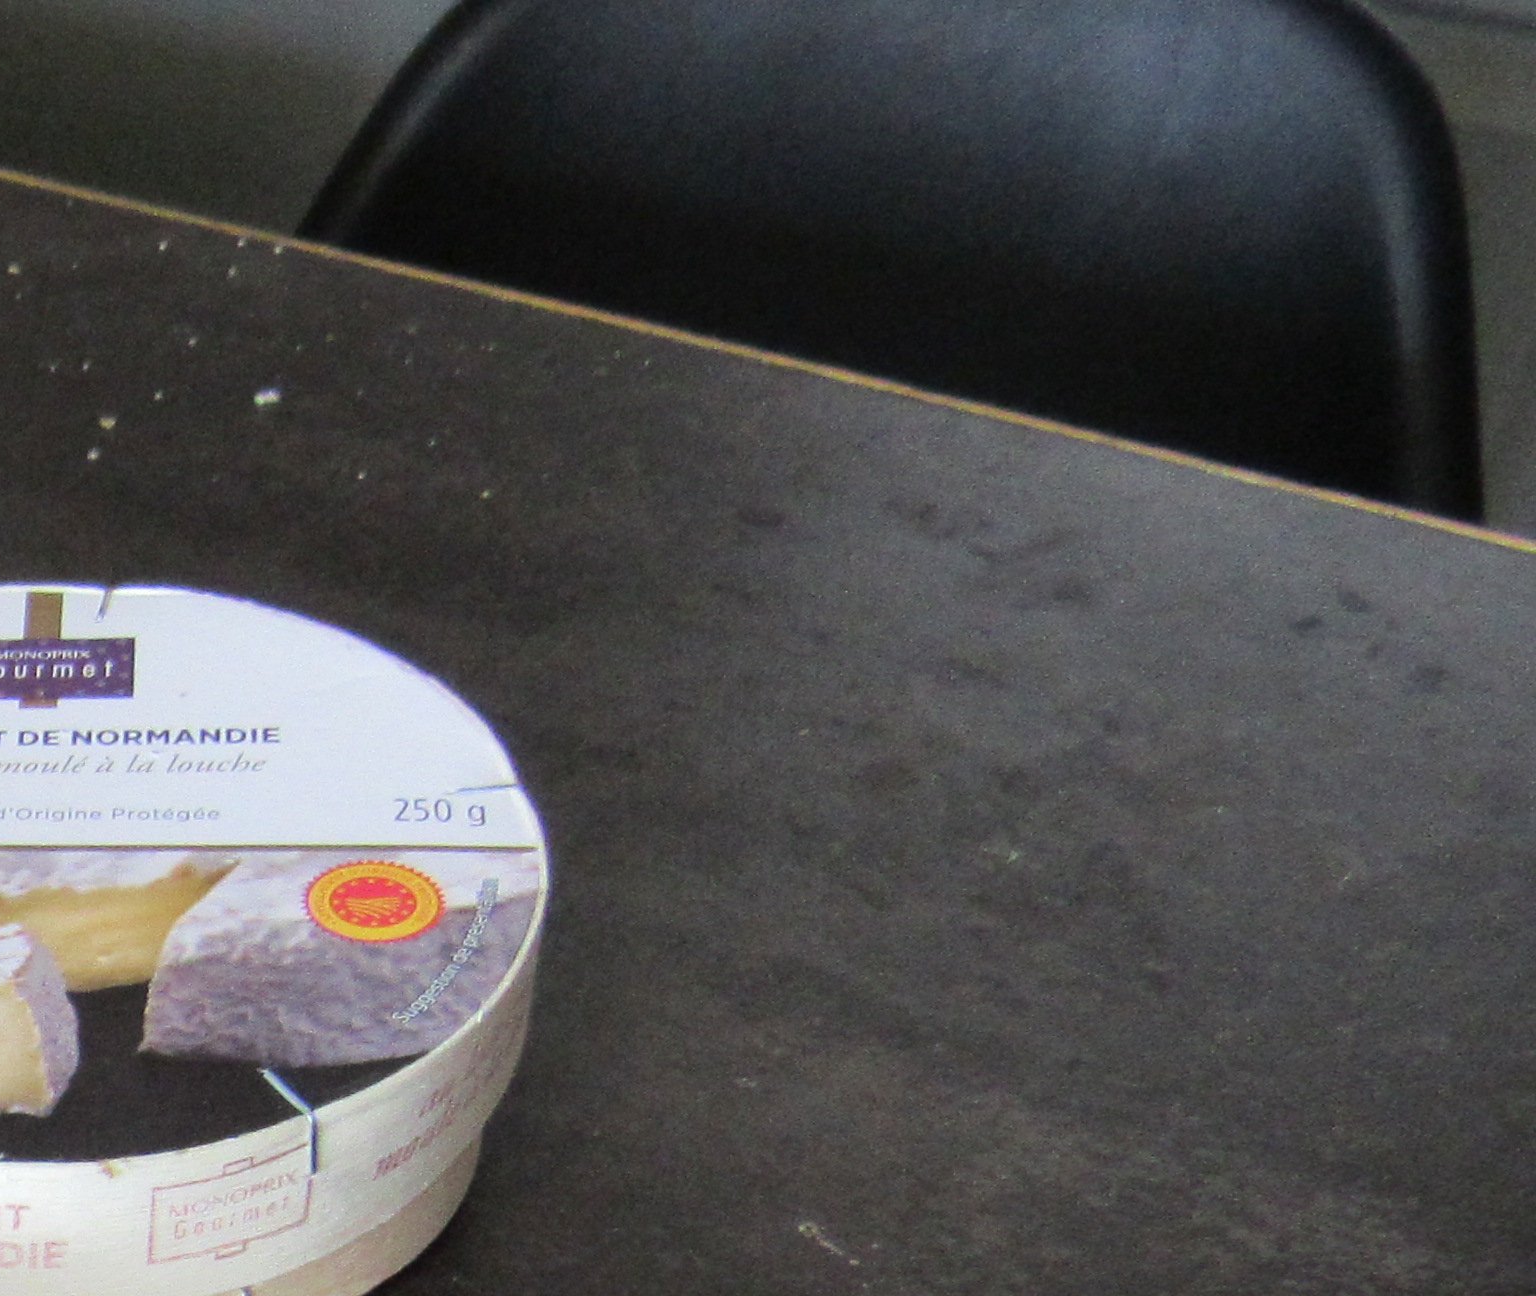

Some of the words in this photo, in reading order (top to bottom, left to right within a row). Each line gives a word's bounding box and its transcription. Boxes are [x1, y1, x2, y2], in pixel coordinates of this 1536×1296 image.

[18, 729, 60, 747] DE
[71, 726, 282, 747] NORMANDIE
[95, 755, 116, 774] à
[124, 753, 156, 775] la
[165, 753, 268, 774] louche
[111, 805, 221, 824] Protégée
[394, 798, 452, 822] 250
[467, 803, 488, 827] g
[391, 961, 462, 1025] Suggestion
[451, 944, 472, 967] de
